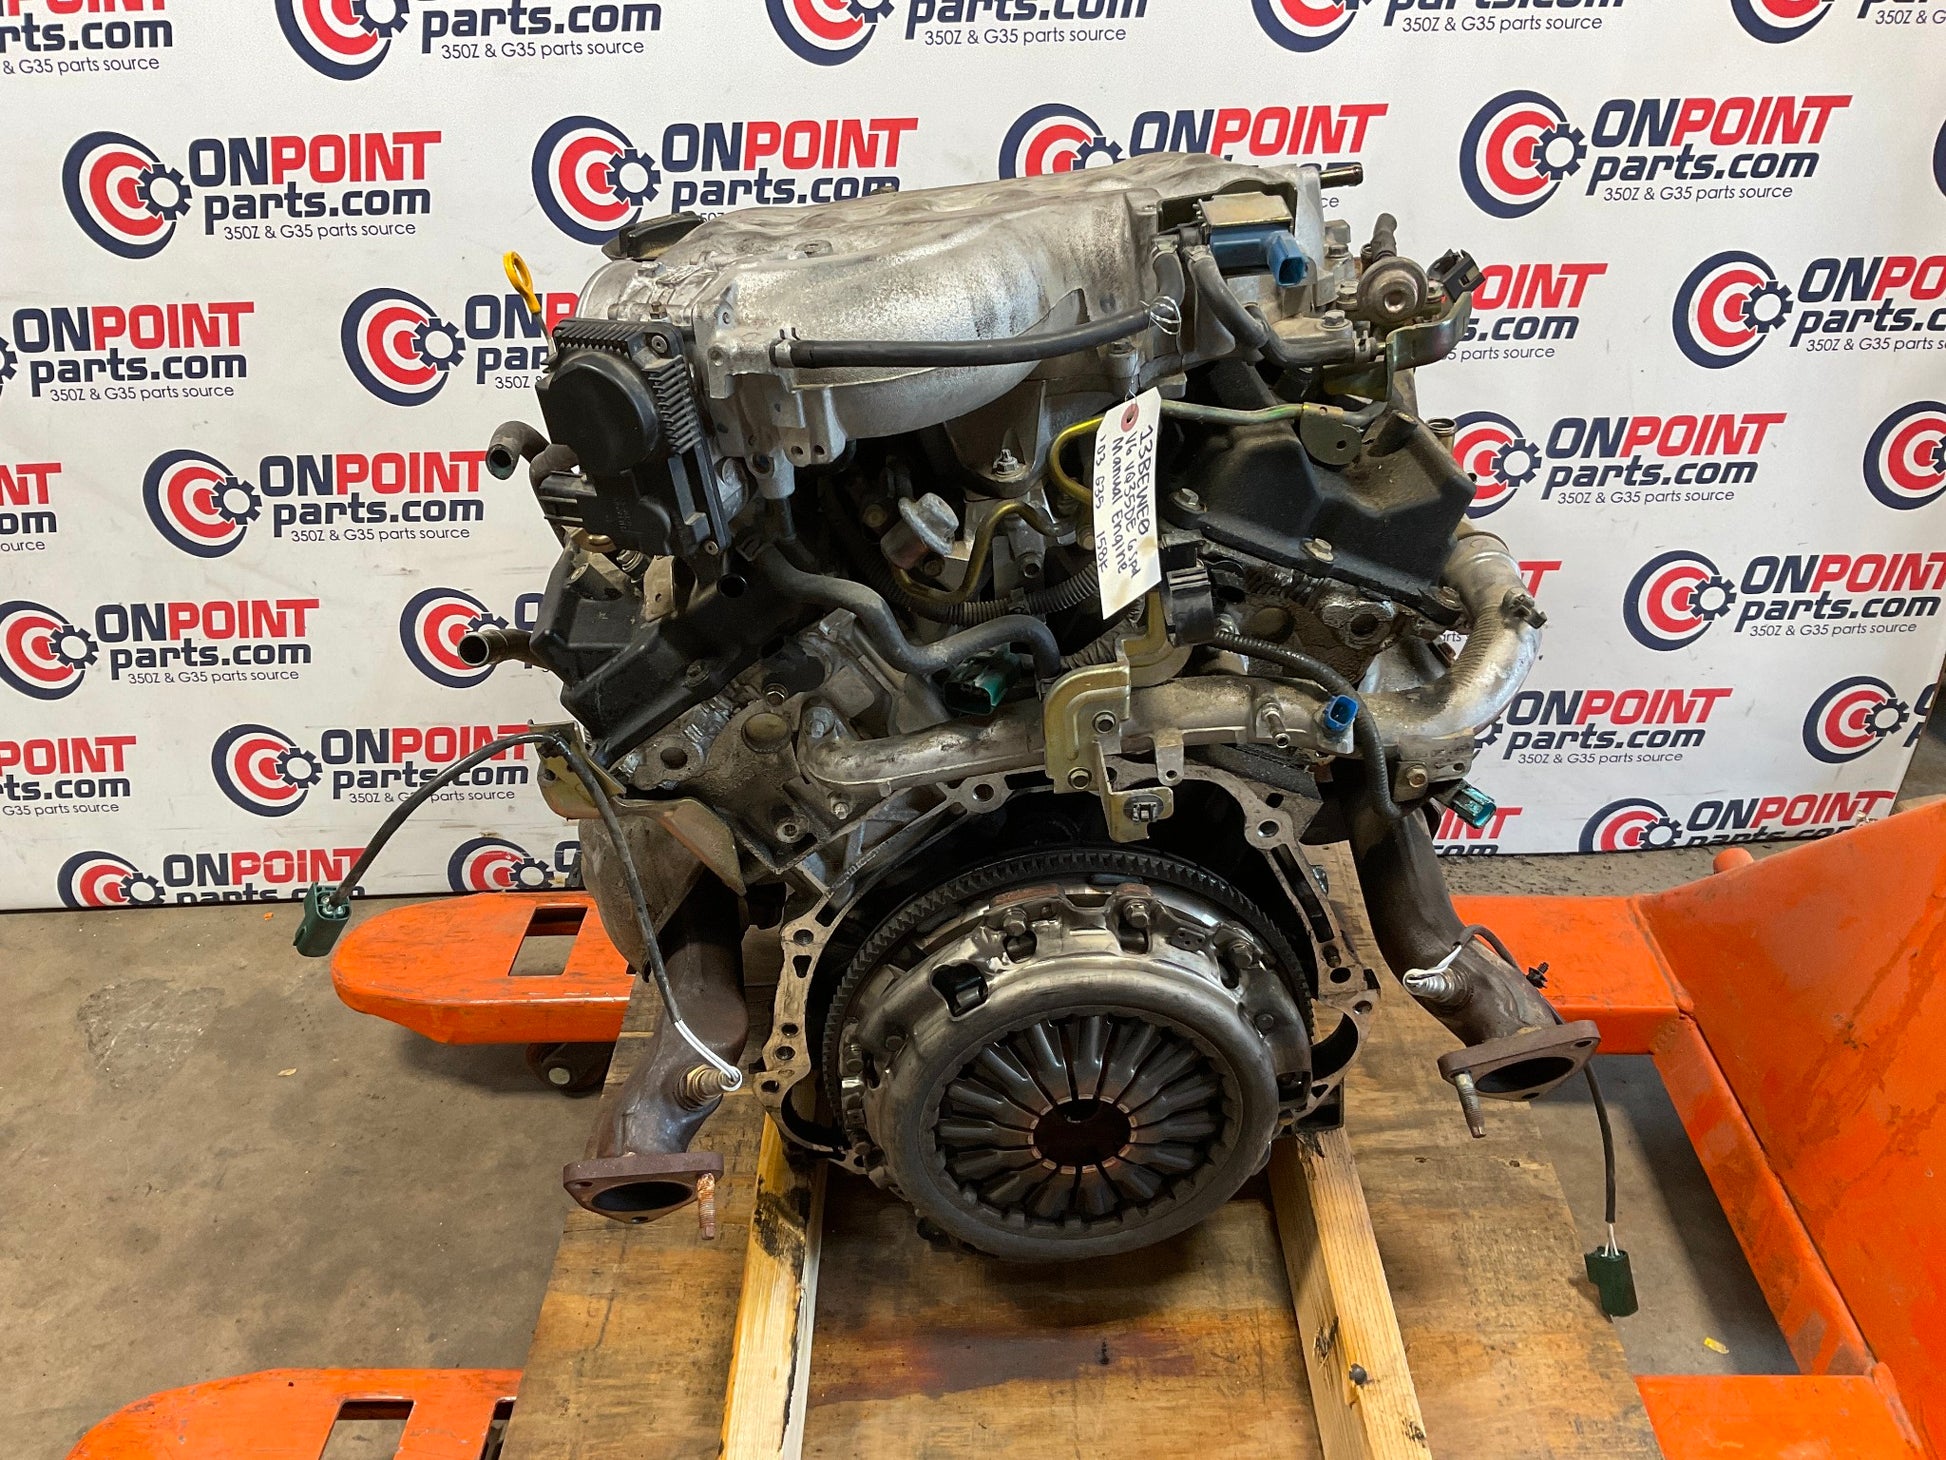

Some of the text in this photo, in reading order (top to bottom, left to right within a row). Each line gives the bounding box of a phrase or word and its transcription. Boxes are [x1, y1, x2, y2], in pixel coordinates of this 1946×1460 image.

[0, 13, 173, 53] rts.com
[422, 0, 661, 54] parts.com
[924, 27, 1126, 45] 350Z & G35 parts source
[1402, 15, 1602, 33] 350Z & G35 parts source
[1875, 10, 1913, 24] 350Z
[1916, 10, 1927, 24] &
[3, 57, 160, 75] & G35 parts source
[441, 40, 644, 59] 350Z & G35 parts source
[1129, 103, 1389, 158] ONPOINT
[1591, 95, 1853, 147] ONPOINT
[189, 131, 442, 187] ONPOINT
[661, 118, 919, 172] ONPOINT
[1585, 143, 1819, 196] parts.com
[204, 182, 431, 235] parts.com
[671, 168, 900, 214] parts.com
[1603, 184, 1792, 202] 350Z & G35 parts source
[224, 222, 416, 240] 350Z & G35 parts source
[1471, 263, 1608, 310] OINT
[1798, 255, 1946, 303] ONPO
[12, 301, 255, 353] ONPOINT
[1459, 316, 1579, 341] s.com
[1789, 298, 1946, 347] parts.c
[1460, 347, 1499, 362] parts
[1503, 347, 1555, 360] source
[1806, 338, 1841, 351] 350Z
[1844, 338, 1854, 350] &
[1859, 337, 1891, 350] G35
[1893, 337, 1934, 352] parts
[30, 348, 247, 397] parts.com
[495, 376, 530, 389] 350Z
[50, 385, 234, 401] 350Z & G35 parts source
[1125, 431, 1138, 456] V6
[1545, 413, 1787, 458] ONPOINT
[259, 451, 487, 497] ONPOINT
[1094, 476, 1105, 510] G35
[1541, 455, 1759, 500] parts.com
[273, 492, 484, 538] parts.com
[1111, 436, 1127, 574] Manual Engine
[1124, 461, 1136, 533] VQ35DE
[1558, 490, 1735, 505] 350Z & G35 parts source
[0, 541, 45, 552] ource
[291, 527, 470, 542] 350Z & G35 parts source
[95, 598, 320, 643] ONPOINT
[1734, 591, 1941, 633] parts.com
[1749, 623, 1917, 637] 350Z & G35 parts source
[110, 638, 311, 680] parts.com
[127, 670, 299, 684] 350Z & G35 parts source
[1506, 687, 1733, 726] ONPOINT
[0, 736, 136, 777] POINT
[321, 724, 530, 765] ONPOINT
[1502, 723, 1706, 760] parts.com
[1518, 752, 1683, 765] 350Z & G35 parts source
[0, 774, 131, 801] ts.com
[349, 793, 380, 803] 350Z
[385, 793, 394, 802] &
[430, 791, 515, 803] parts source
[2, 803, 119, 817] G35 parts source
